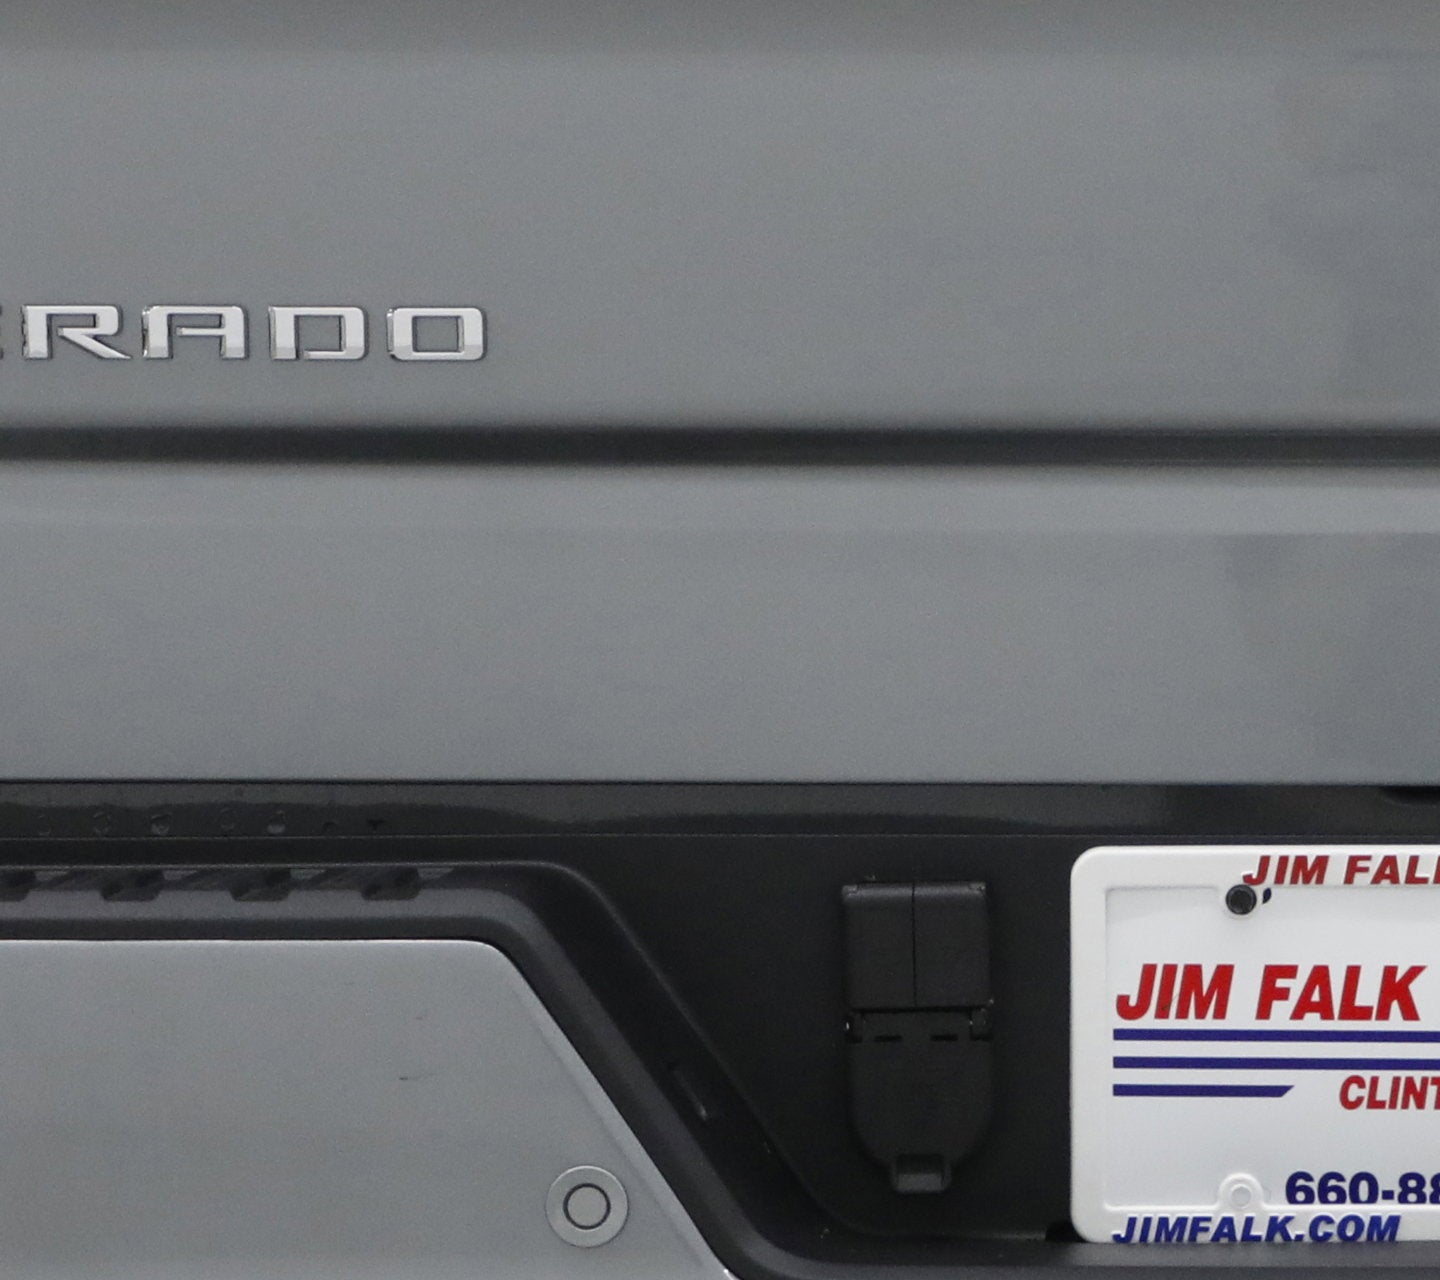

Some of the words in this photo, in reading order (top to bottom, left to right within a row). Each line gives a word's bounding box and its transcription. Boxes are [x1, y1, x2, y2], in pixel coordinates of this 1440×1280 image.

[1242, 854, 1328, 886] JIM
[1115, 963, 1235, 1022] JIM
[1255, 965, 1428, 1022] FALK
[1111, 1215, 1401, 1245] JIMFALK.COM
